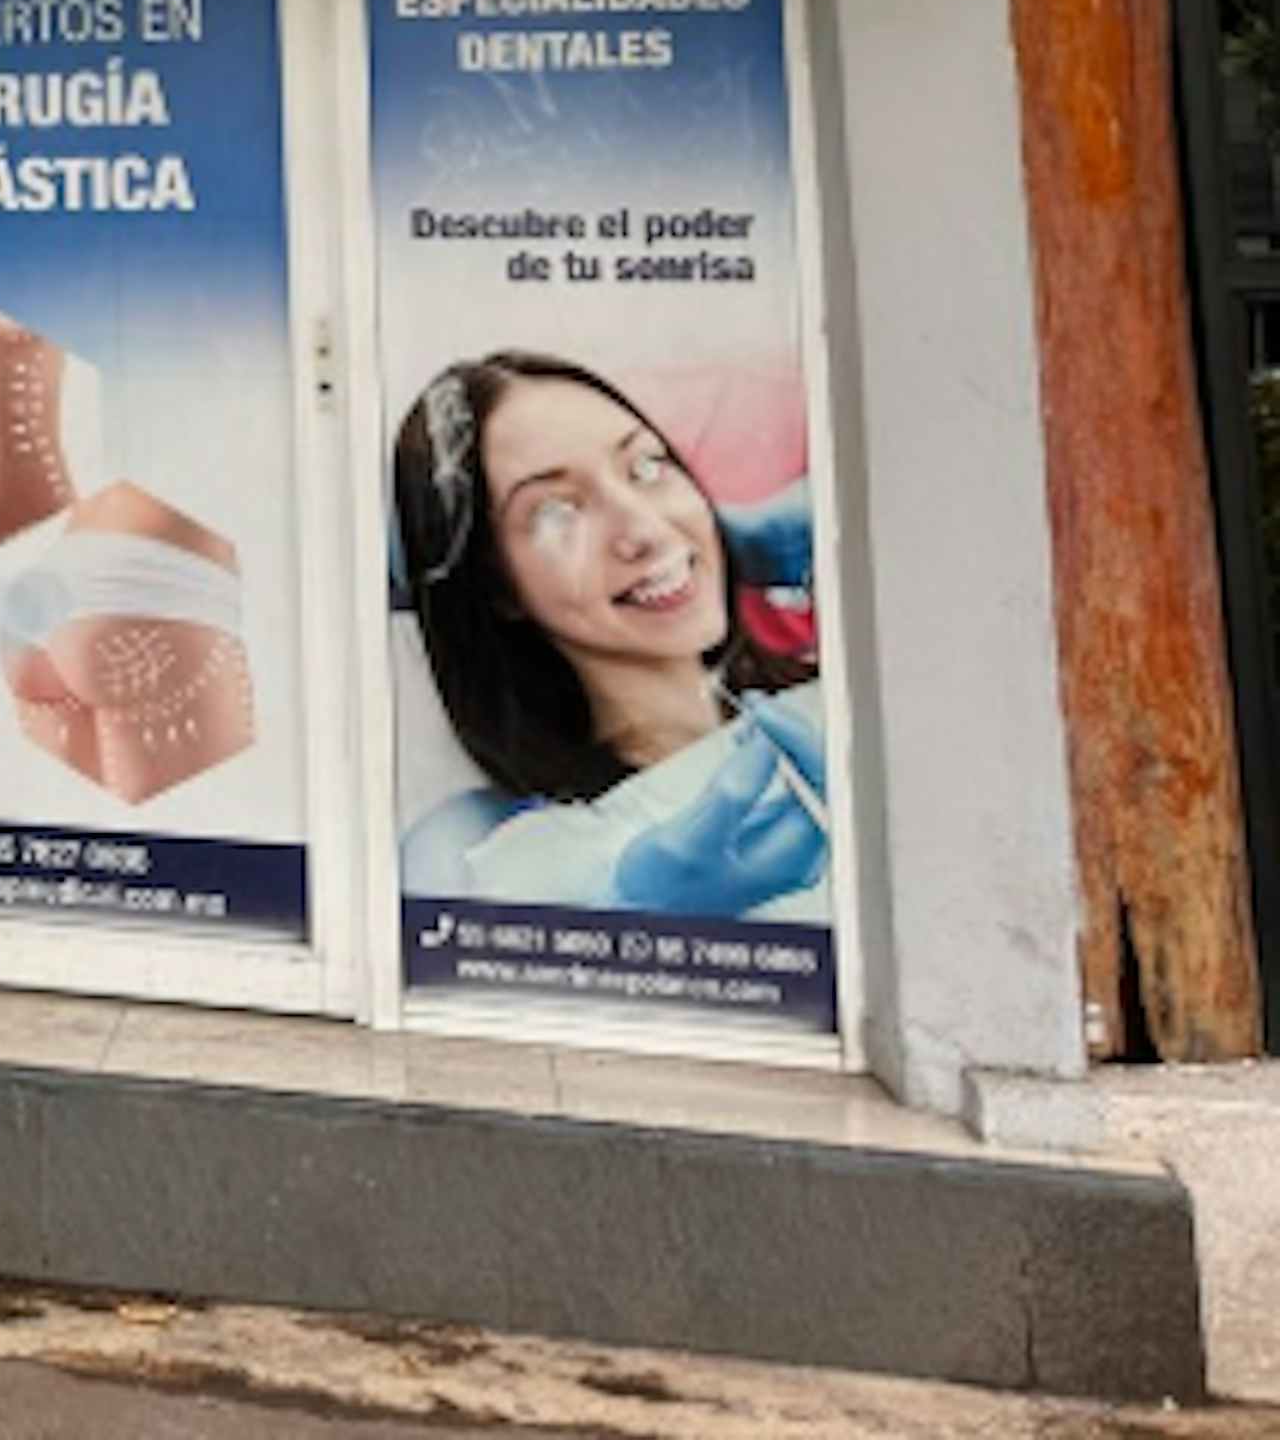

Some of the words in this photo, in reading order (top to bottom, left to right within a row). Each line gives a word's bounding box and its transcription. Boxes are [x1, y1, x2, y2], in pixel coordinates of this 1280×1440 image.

[458, 30, 674, 71] DENTALES
[411, 209, 586, 239] Descubre
[597, 209, 629, 239] el
[645, 209, 755, 247] poder
[507, 251, 551, 281] de
[563, 251, 601, 281] tu
[615, 251, 756, 281] sonrisa
